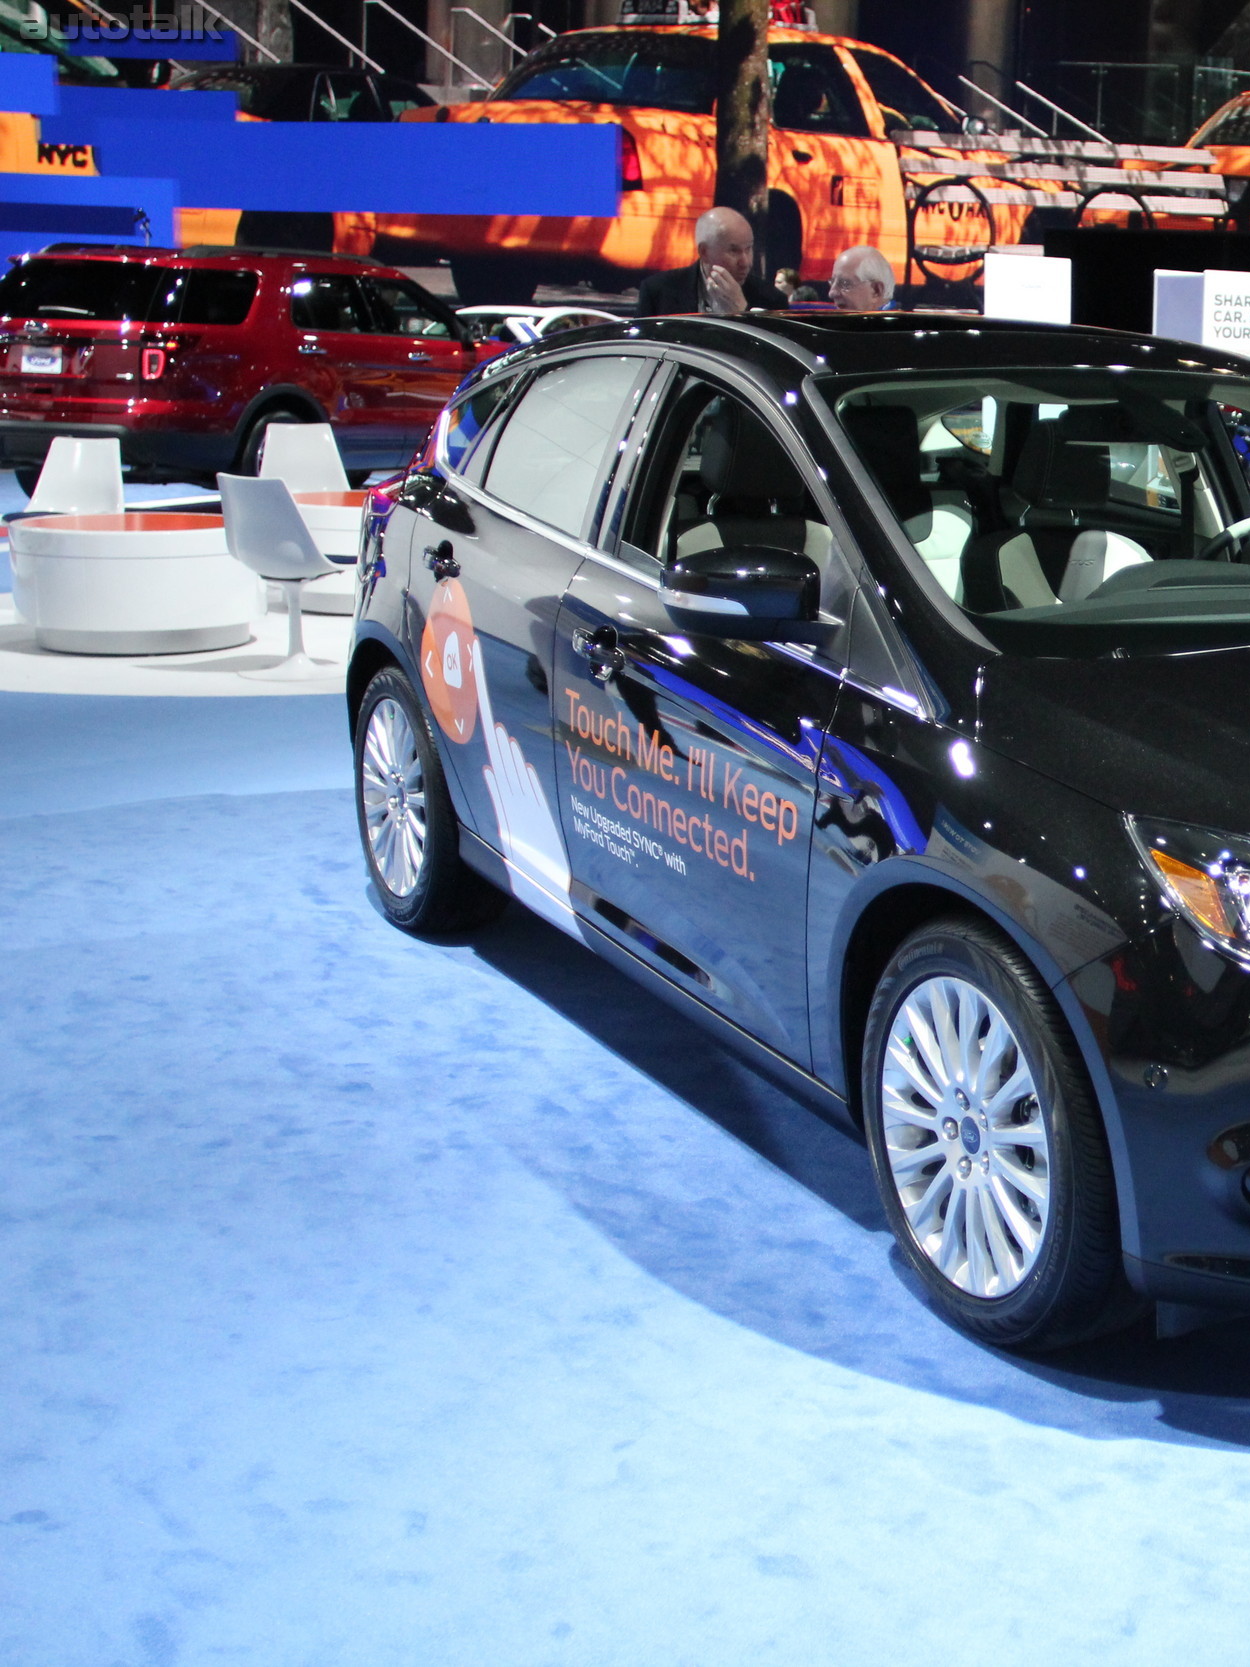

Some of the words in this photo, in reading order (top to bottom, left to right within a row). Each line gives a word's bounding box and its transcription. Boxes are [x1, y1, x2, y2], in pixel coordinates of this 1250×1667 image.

[37, 144, 88, 168] NYC
[1213, 310, 1246, 323] CAR.
[1213, 326, 1250, 339] YOUR
[447, 653, 458, 671] OK
[565, 688, 630, 760] Touch
[638, 722, 679, 783] Me.
[687, 745, 715, 802] I'll
[724, 761, 798, 843] Keep
[565, 741, 605, 799] You
[611, 767, 755, 881] Connected.
[571, 794, 590, 819] New
[589, 805, 632, 844] Upgraded
[664, 851, 686, 876] with
[573, 815, 605, 848] MyFord
